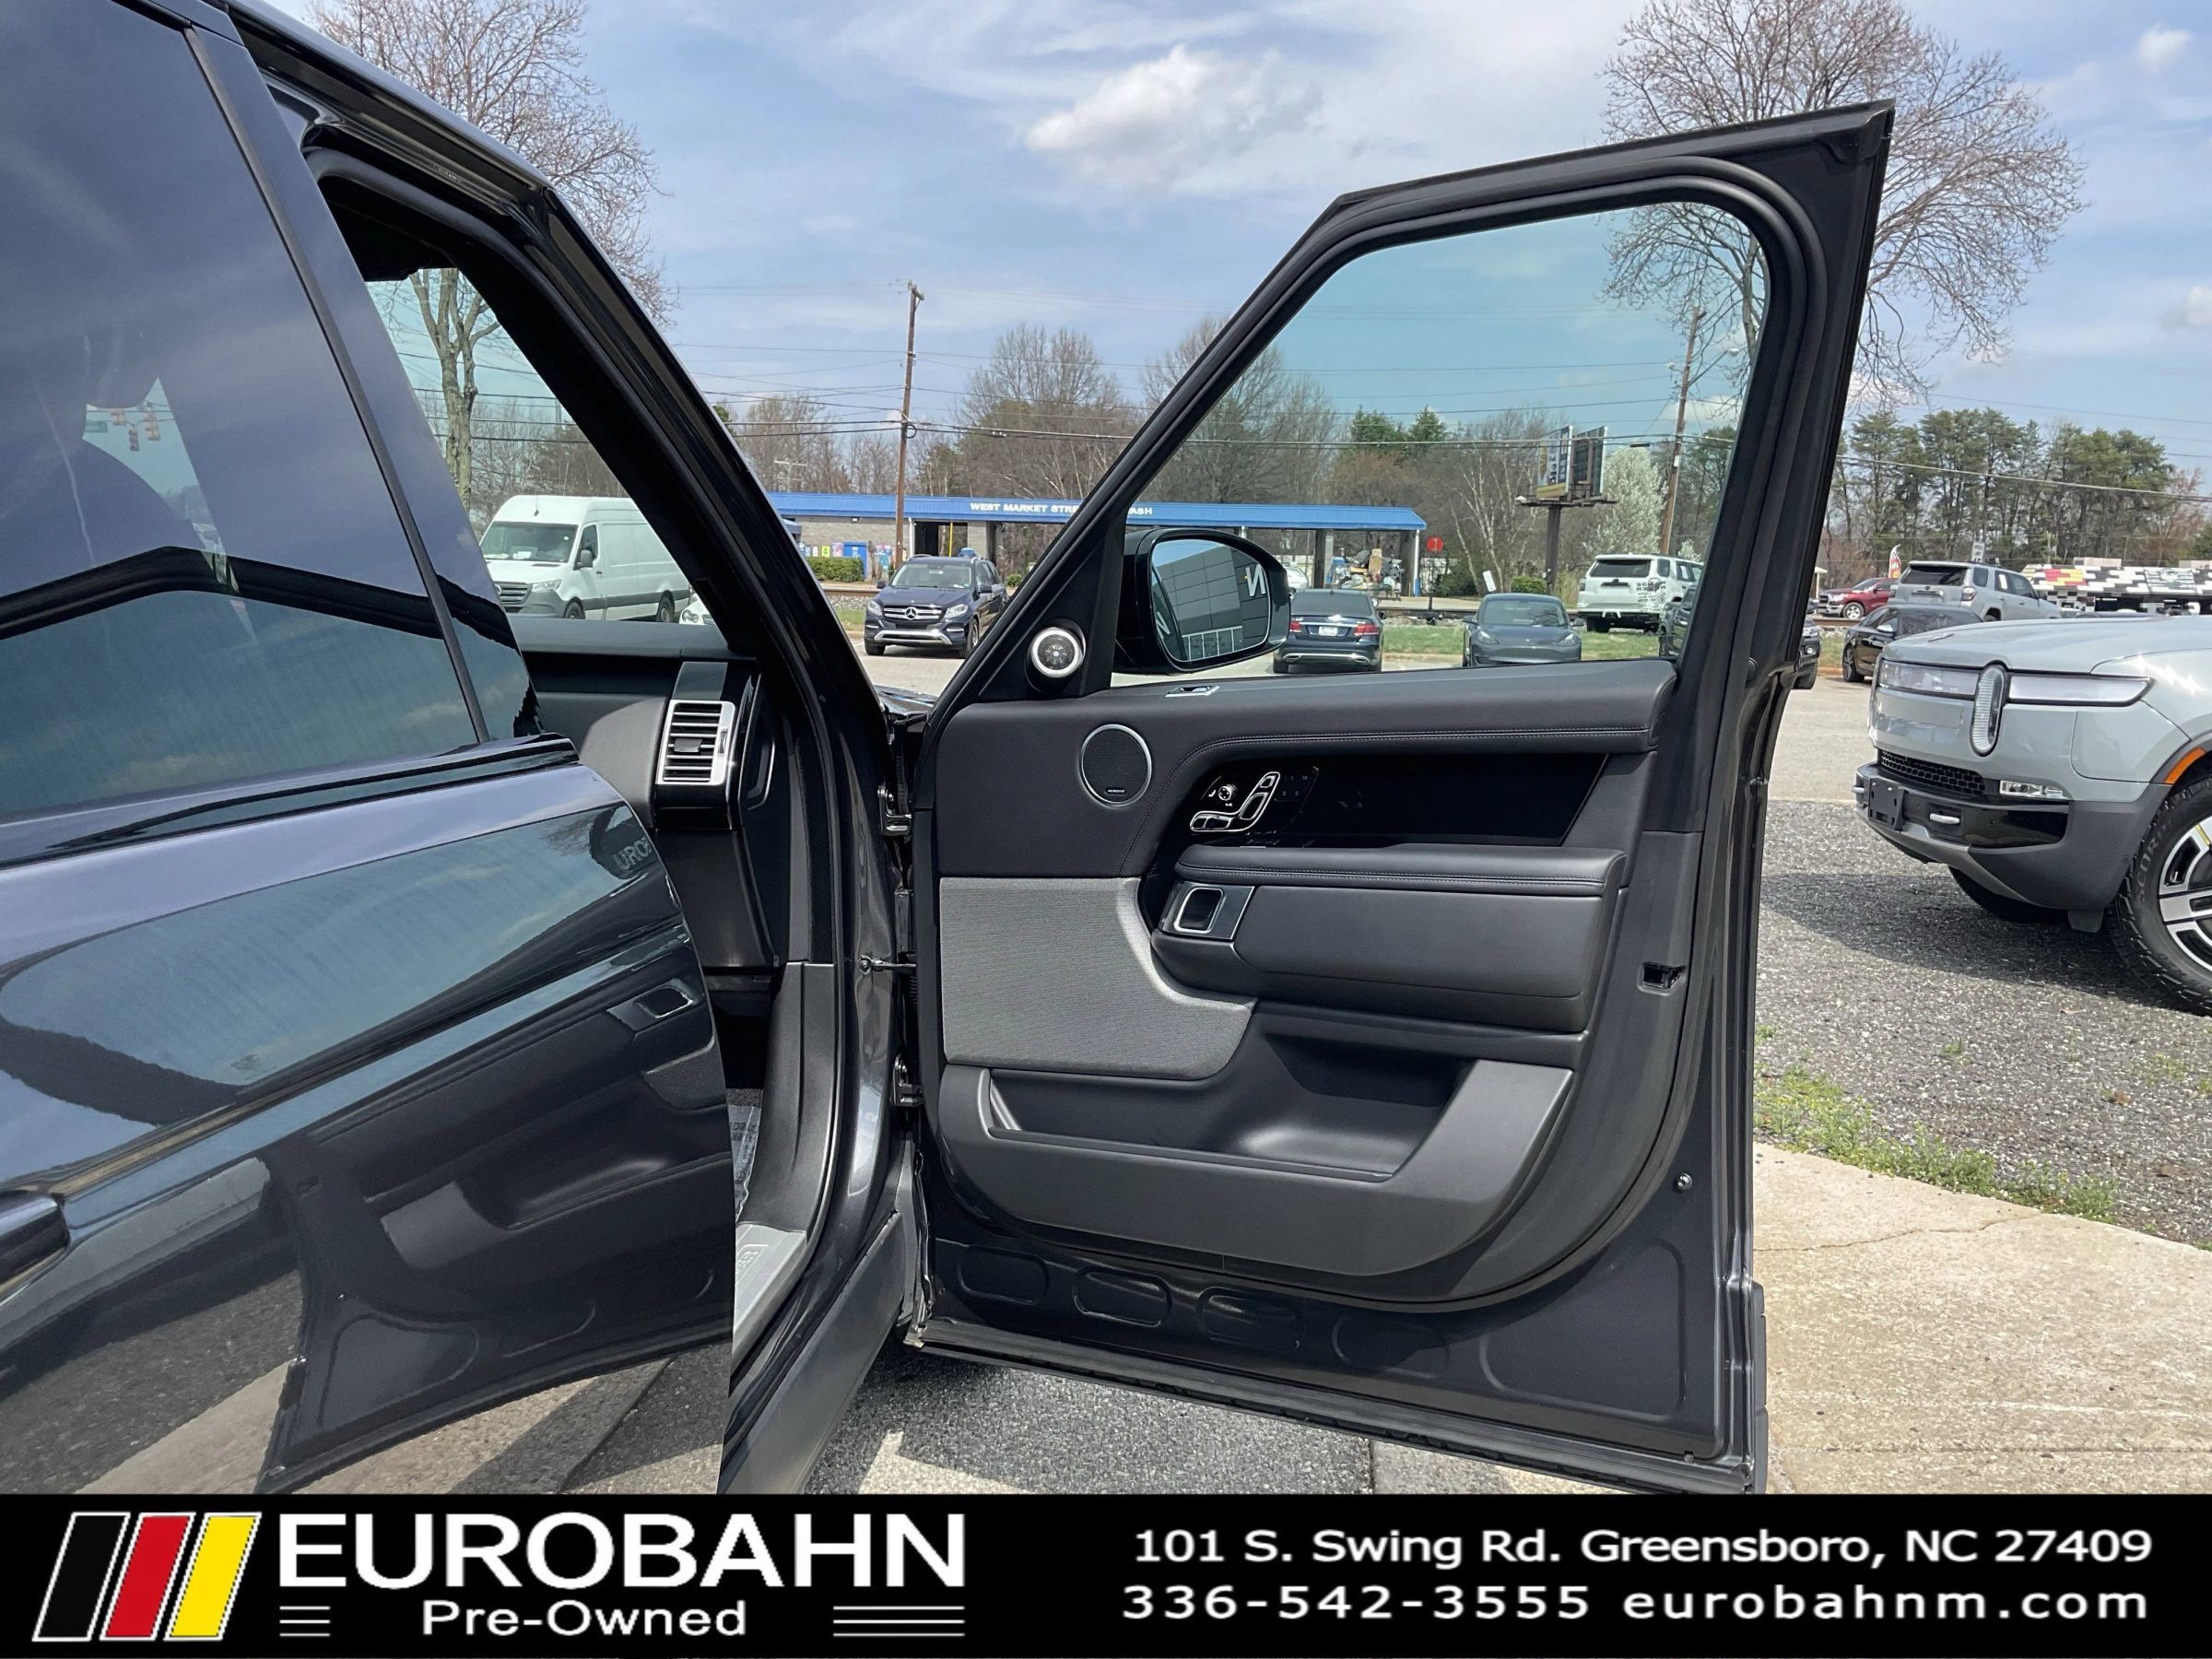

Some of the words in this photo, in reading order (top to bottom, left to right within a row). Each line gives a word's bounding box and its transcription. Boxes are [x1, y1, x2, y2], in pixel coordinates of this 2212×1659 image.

[971, 502, 1001, 512] WEST
[1003, 503, 1048, 513] MARKET
[1051, 504, 1079, 513] STRE
[1127, 507, 1153, 515] ASH
